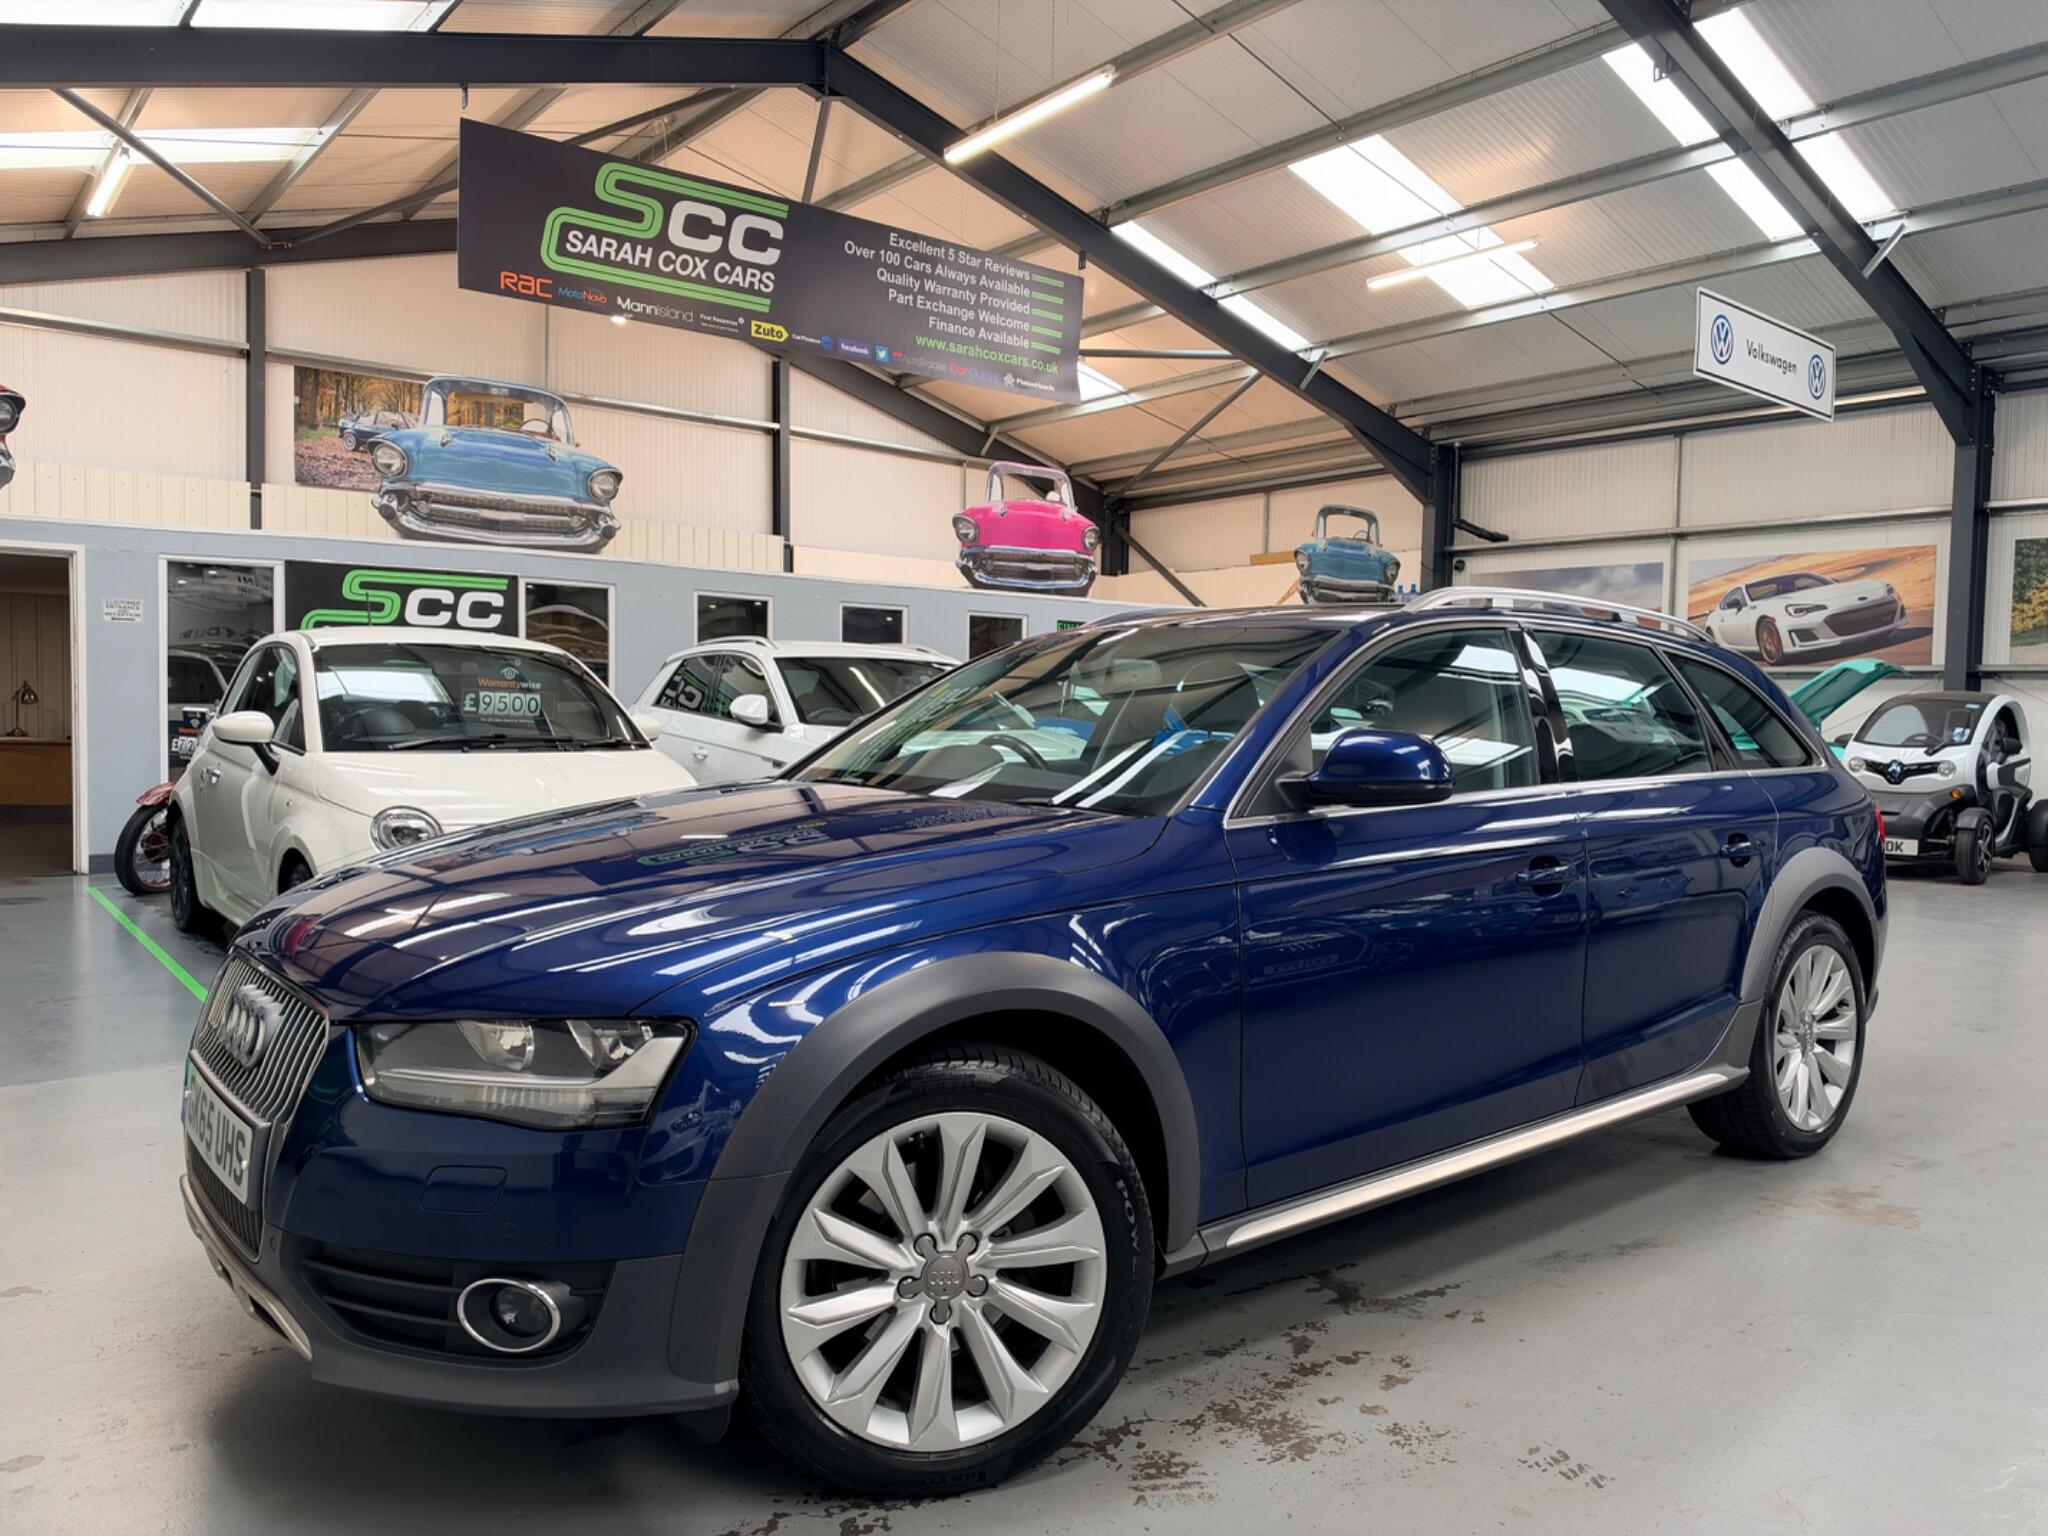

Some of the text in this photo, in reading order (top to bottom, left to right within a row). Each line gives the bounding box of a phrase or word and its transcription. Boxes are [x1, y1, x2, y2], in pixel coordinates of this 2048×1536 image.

[565, 230, 775, 293] SARAH COX CARS
[844, 240, 1030, 298] Over 100 Cars Always Available
[889, 232, 1031, 281] Excellent 5 Star Reviews
[877, 267, 1030, 314] Quality Warranty Provided
[889, 288, 1030, 332] Part Exchange Welcome
[754, 323, 783, 339] Zuto
[841, 342, 869, 355] facebook
[928, 316, 1029, 349] Finance Available
[902, 354, 947, 371] AutoTrader
[916, 335, 1059, 375] www.sarahcoxcars.co.uk
[1746, 339, 1798, 375] Volkswagen
[478, 677, 542, 690] Warrantywise
[463, 691, 540, 715] £9500
[215, 1109, 246, 1187] UHS
